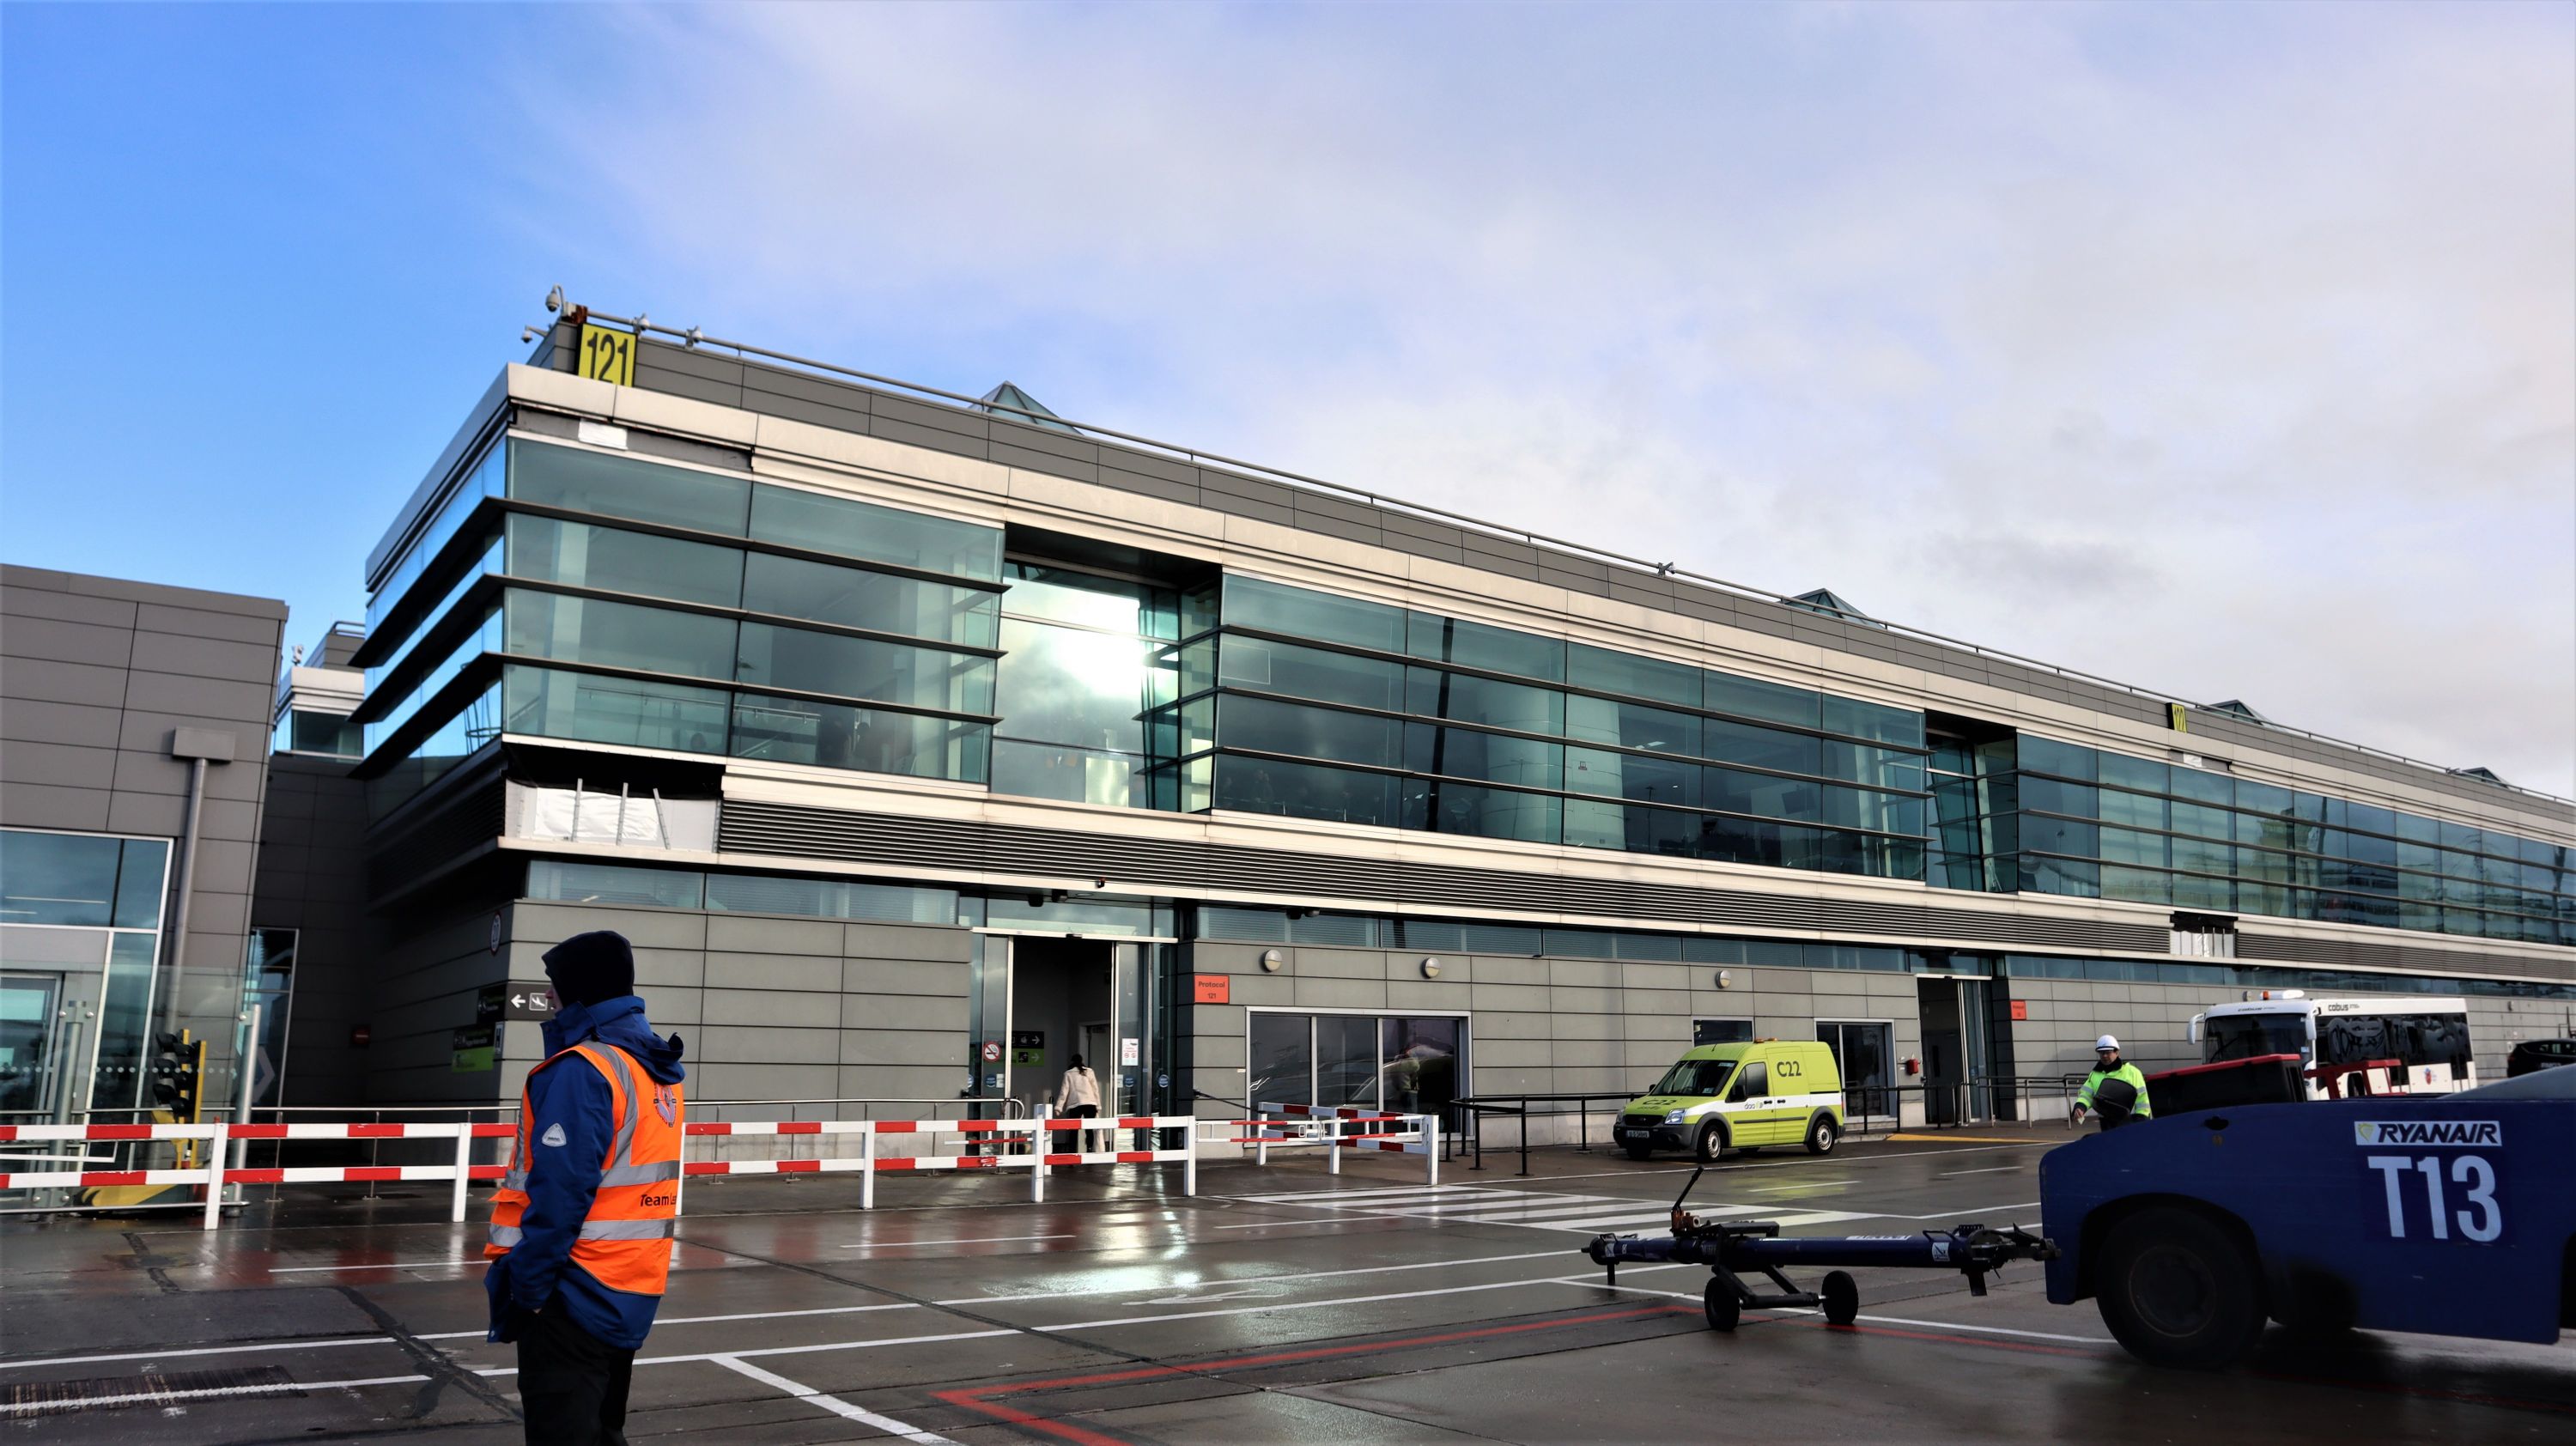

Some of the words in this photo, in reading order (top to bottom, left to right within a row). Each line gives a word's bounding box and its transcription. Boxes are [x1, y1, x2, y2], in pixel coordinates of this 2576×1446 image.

[586, 331, 629, 386] 121
[2328, 1003, 2349, 1012] cobus
[1777, 1060, 1801, 1078] C22
[2378, 1123, 2499, 1144] RYANAIR
[640, 1194, 670, 1207] Team
[2367, 1155, 2502, 1242] T13
